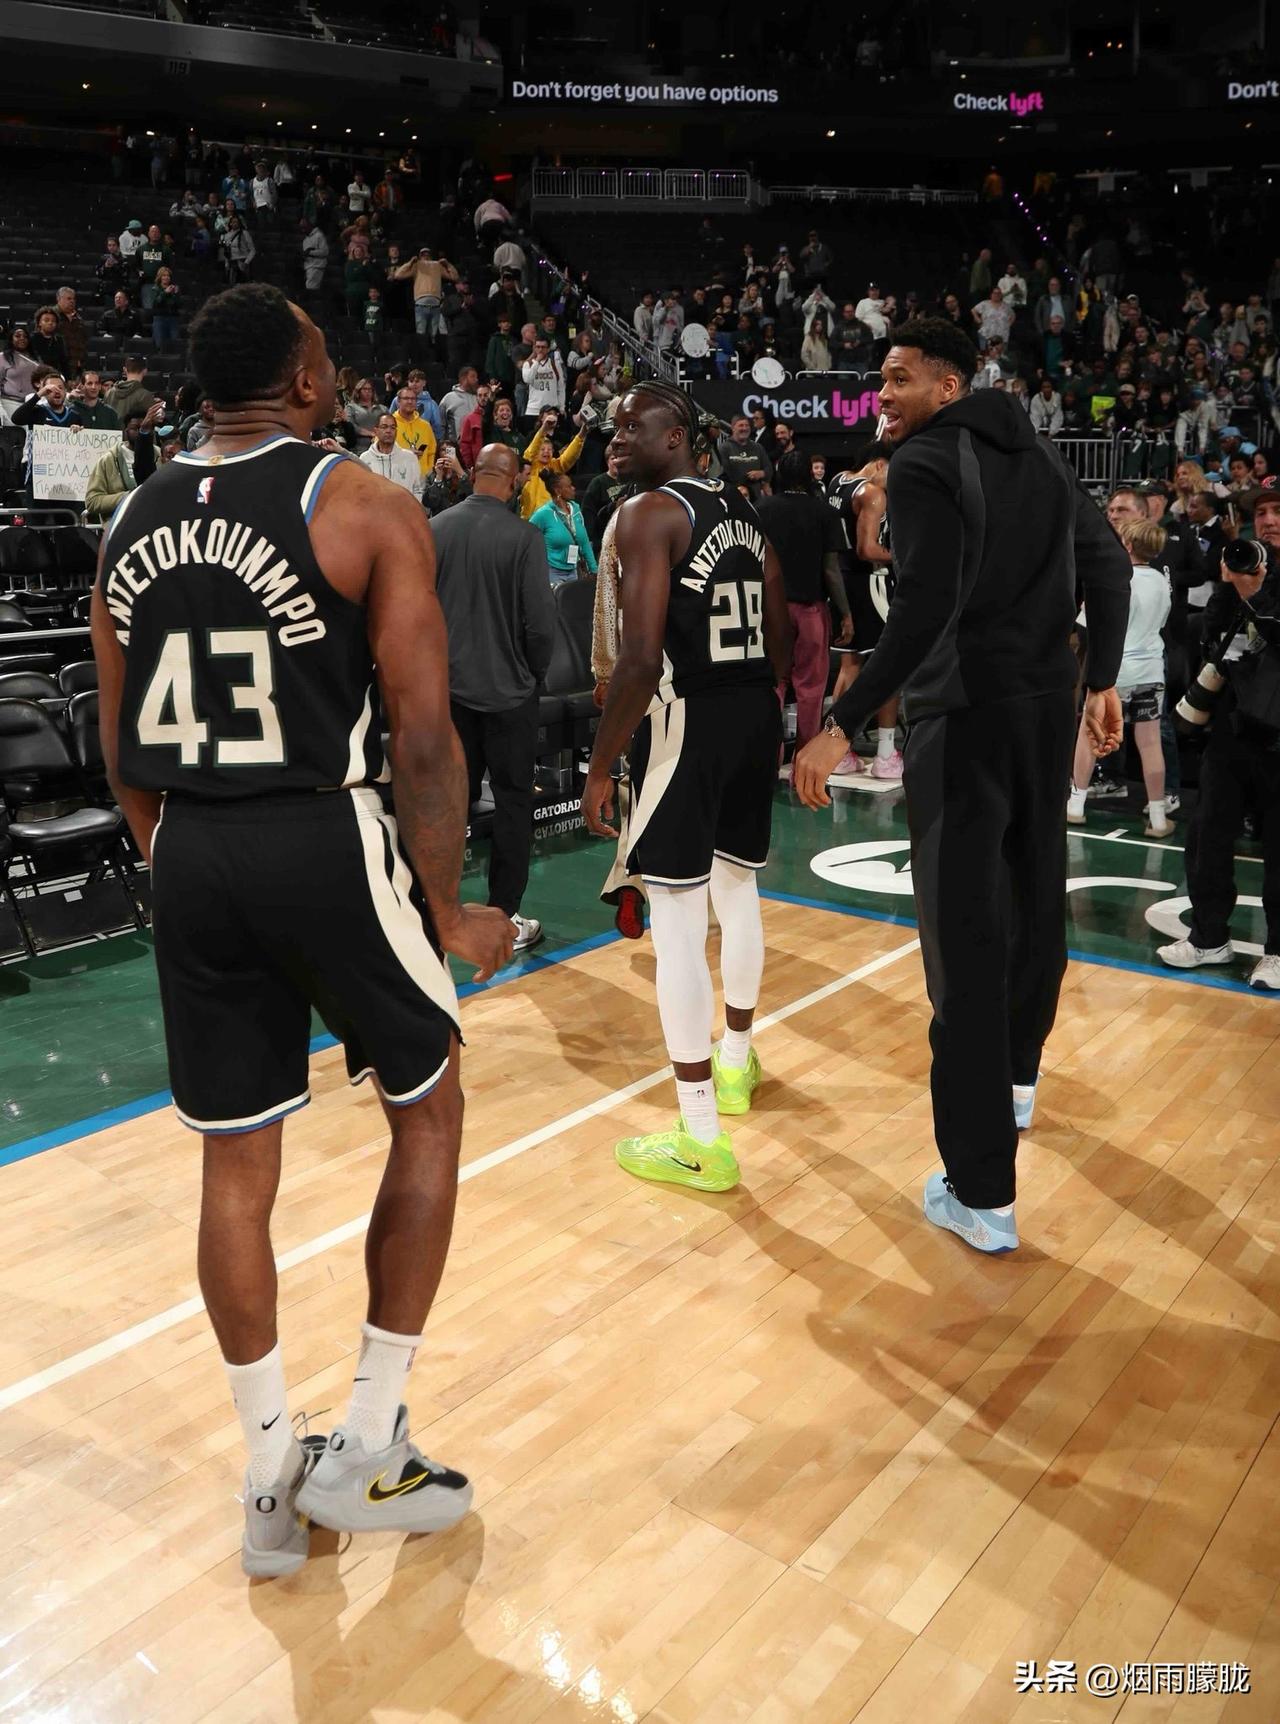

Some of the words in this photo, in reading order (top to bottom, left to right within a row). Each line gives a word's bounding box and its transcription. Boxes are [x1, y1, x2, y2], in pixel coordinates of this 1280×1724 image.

[512, 81, 561, 98] Don't
[564, 82, 621, 101] forget
[625, 84, 659, 102] you
[662, 84, 706, 101] have
[709, 85, 779, 104] options
[1228, 81, 1280, 99] Don't
[953, 93, 1008, 111] Check
[1009, 92, 1044, 117] lyft
[742, 394, 829, 419] Check
[48, 463, 90, 478] ΕΛΛΑΔ
[106, 518, 327, 648] ANTETOKOUNMPO
[709, 580, 766, 663] 29
[136, 628, 286, 766] 43
[533, 798, 583, 821] GATORAD
